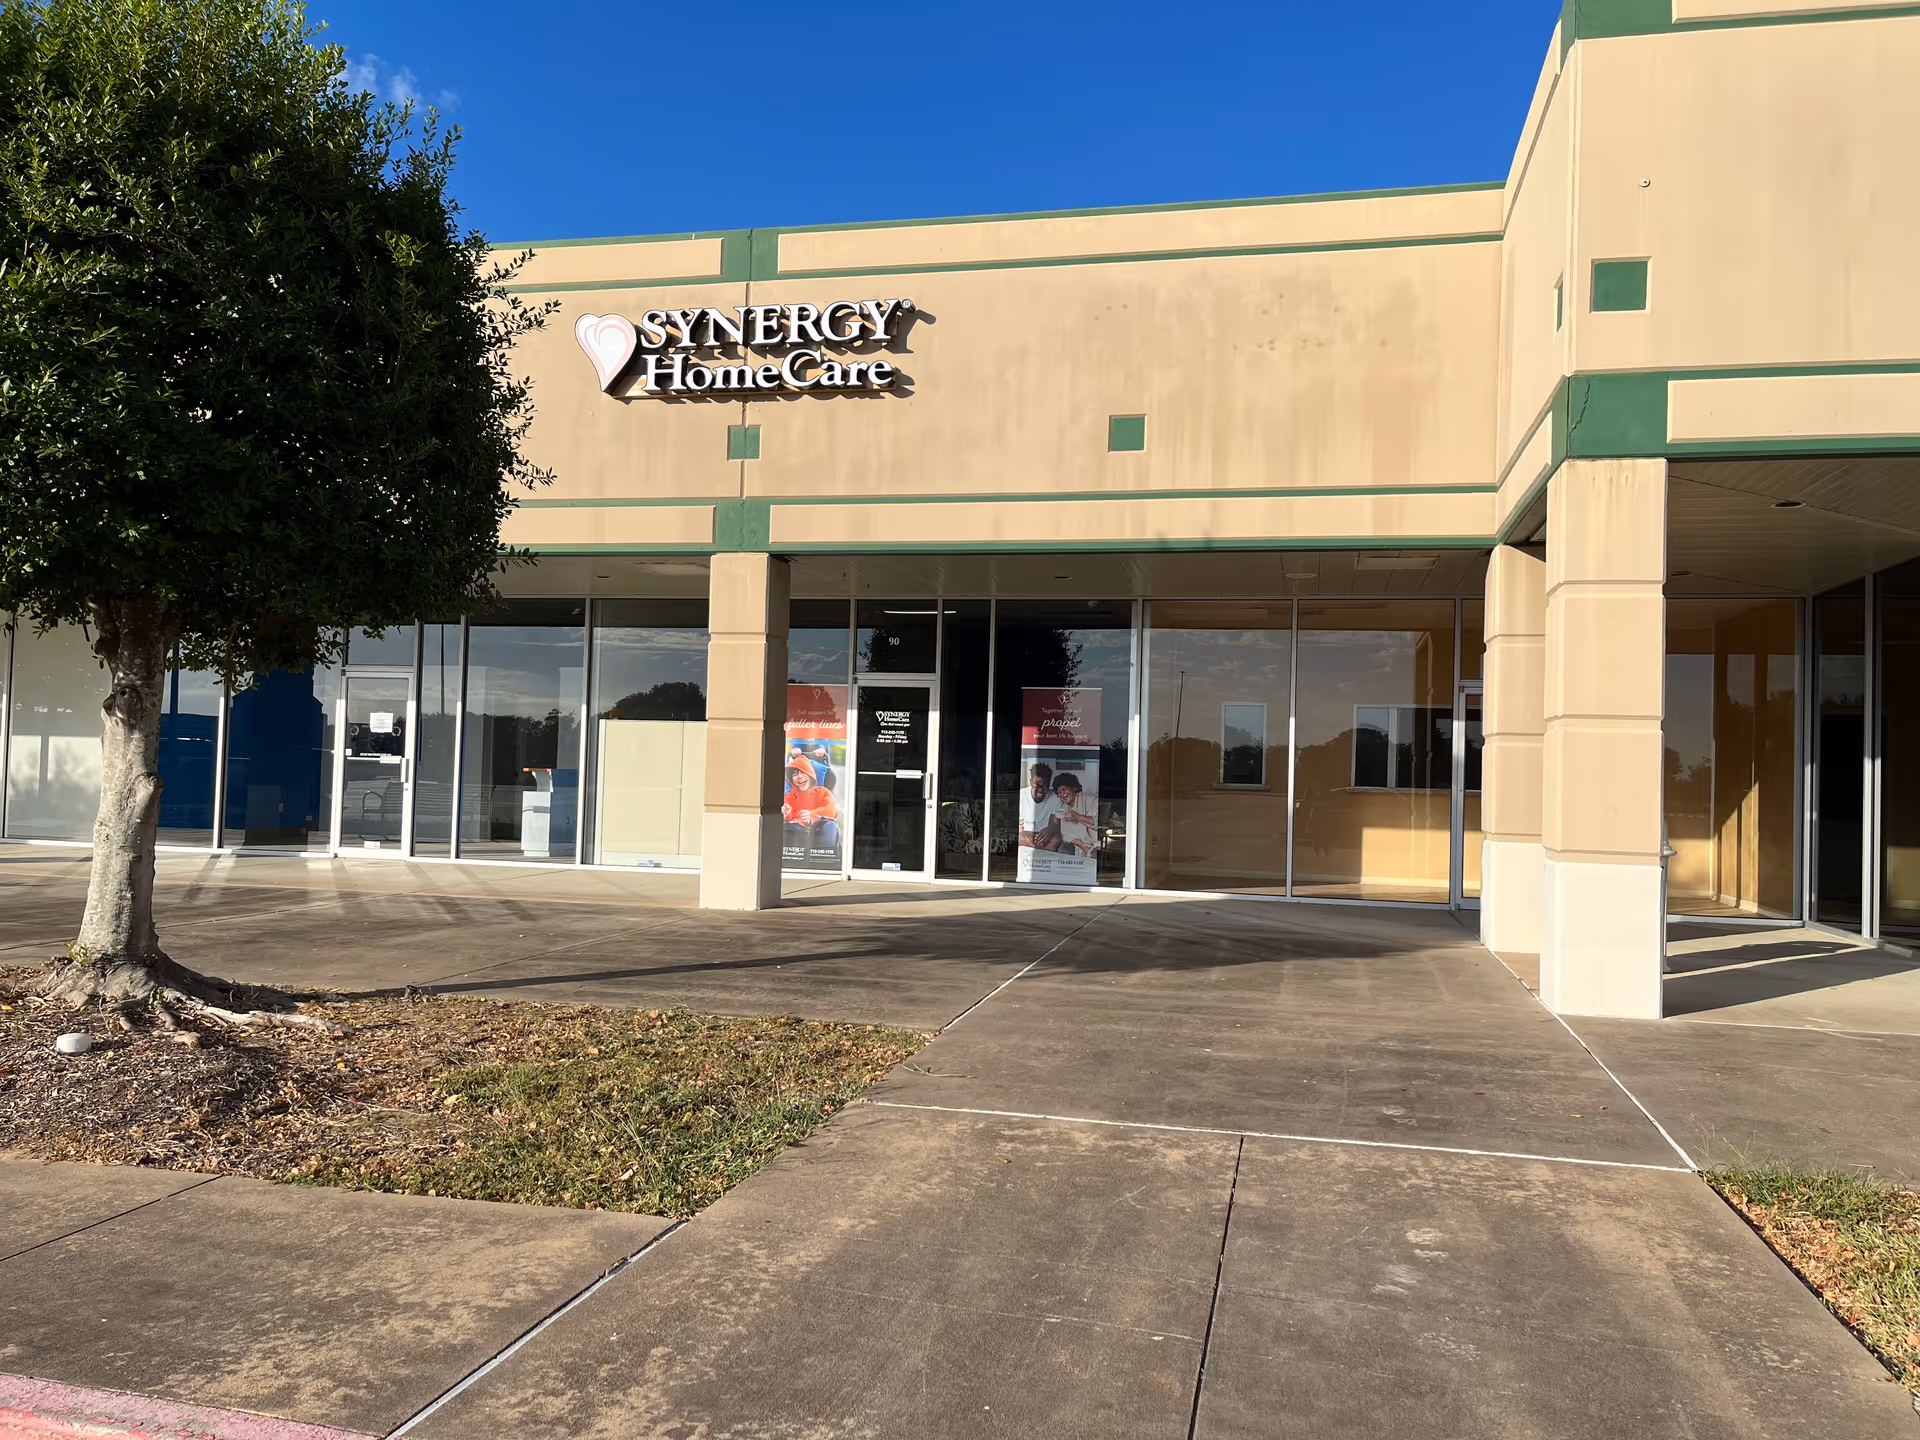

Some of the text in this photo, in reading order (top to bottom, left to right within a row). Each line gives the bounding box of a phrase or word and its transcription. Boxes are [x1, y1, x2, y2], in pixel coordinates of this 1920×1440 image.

[641, 298, 900, 349] SYNERGY
[641, 349, 893, 391] HomeCare
[888, 637, 900, 646] 90
[787, 719, 816, 731] fuller
[1041, 717, 1081, 730] propel
